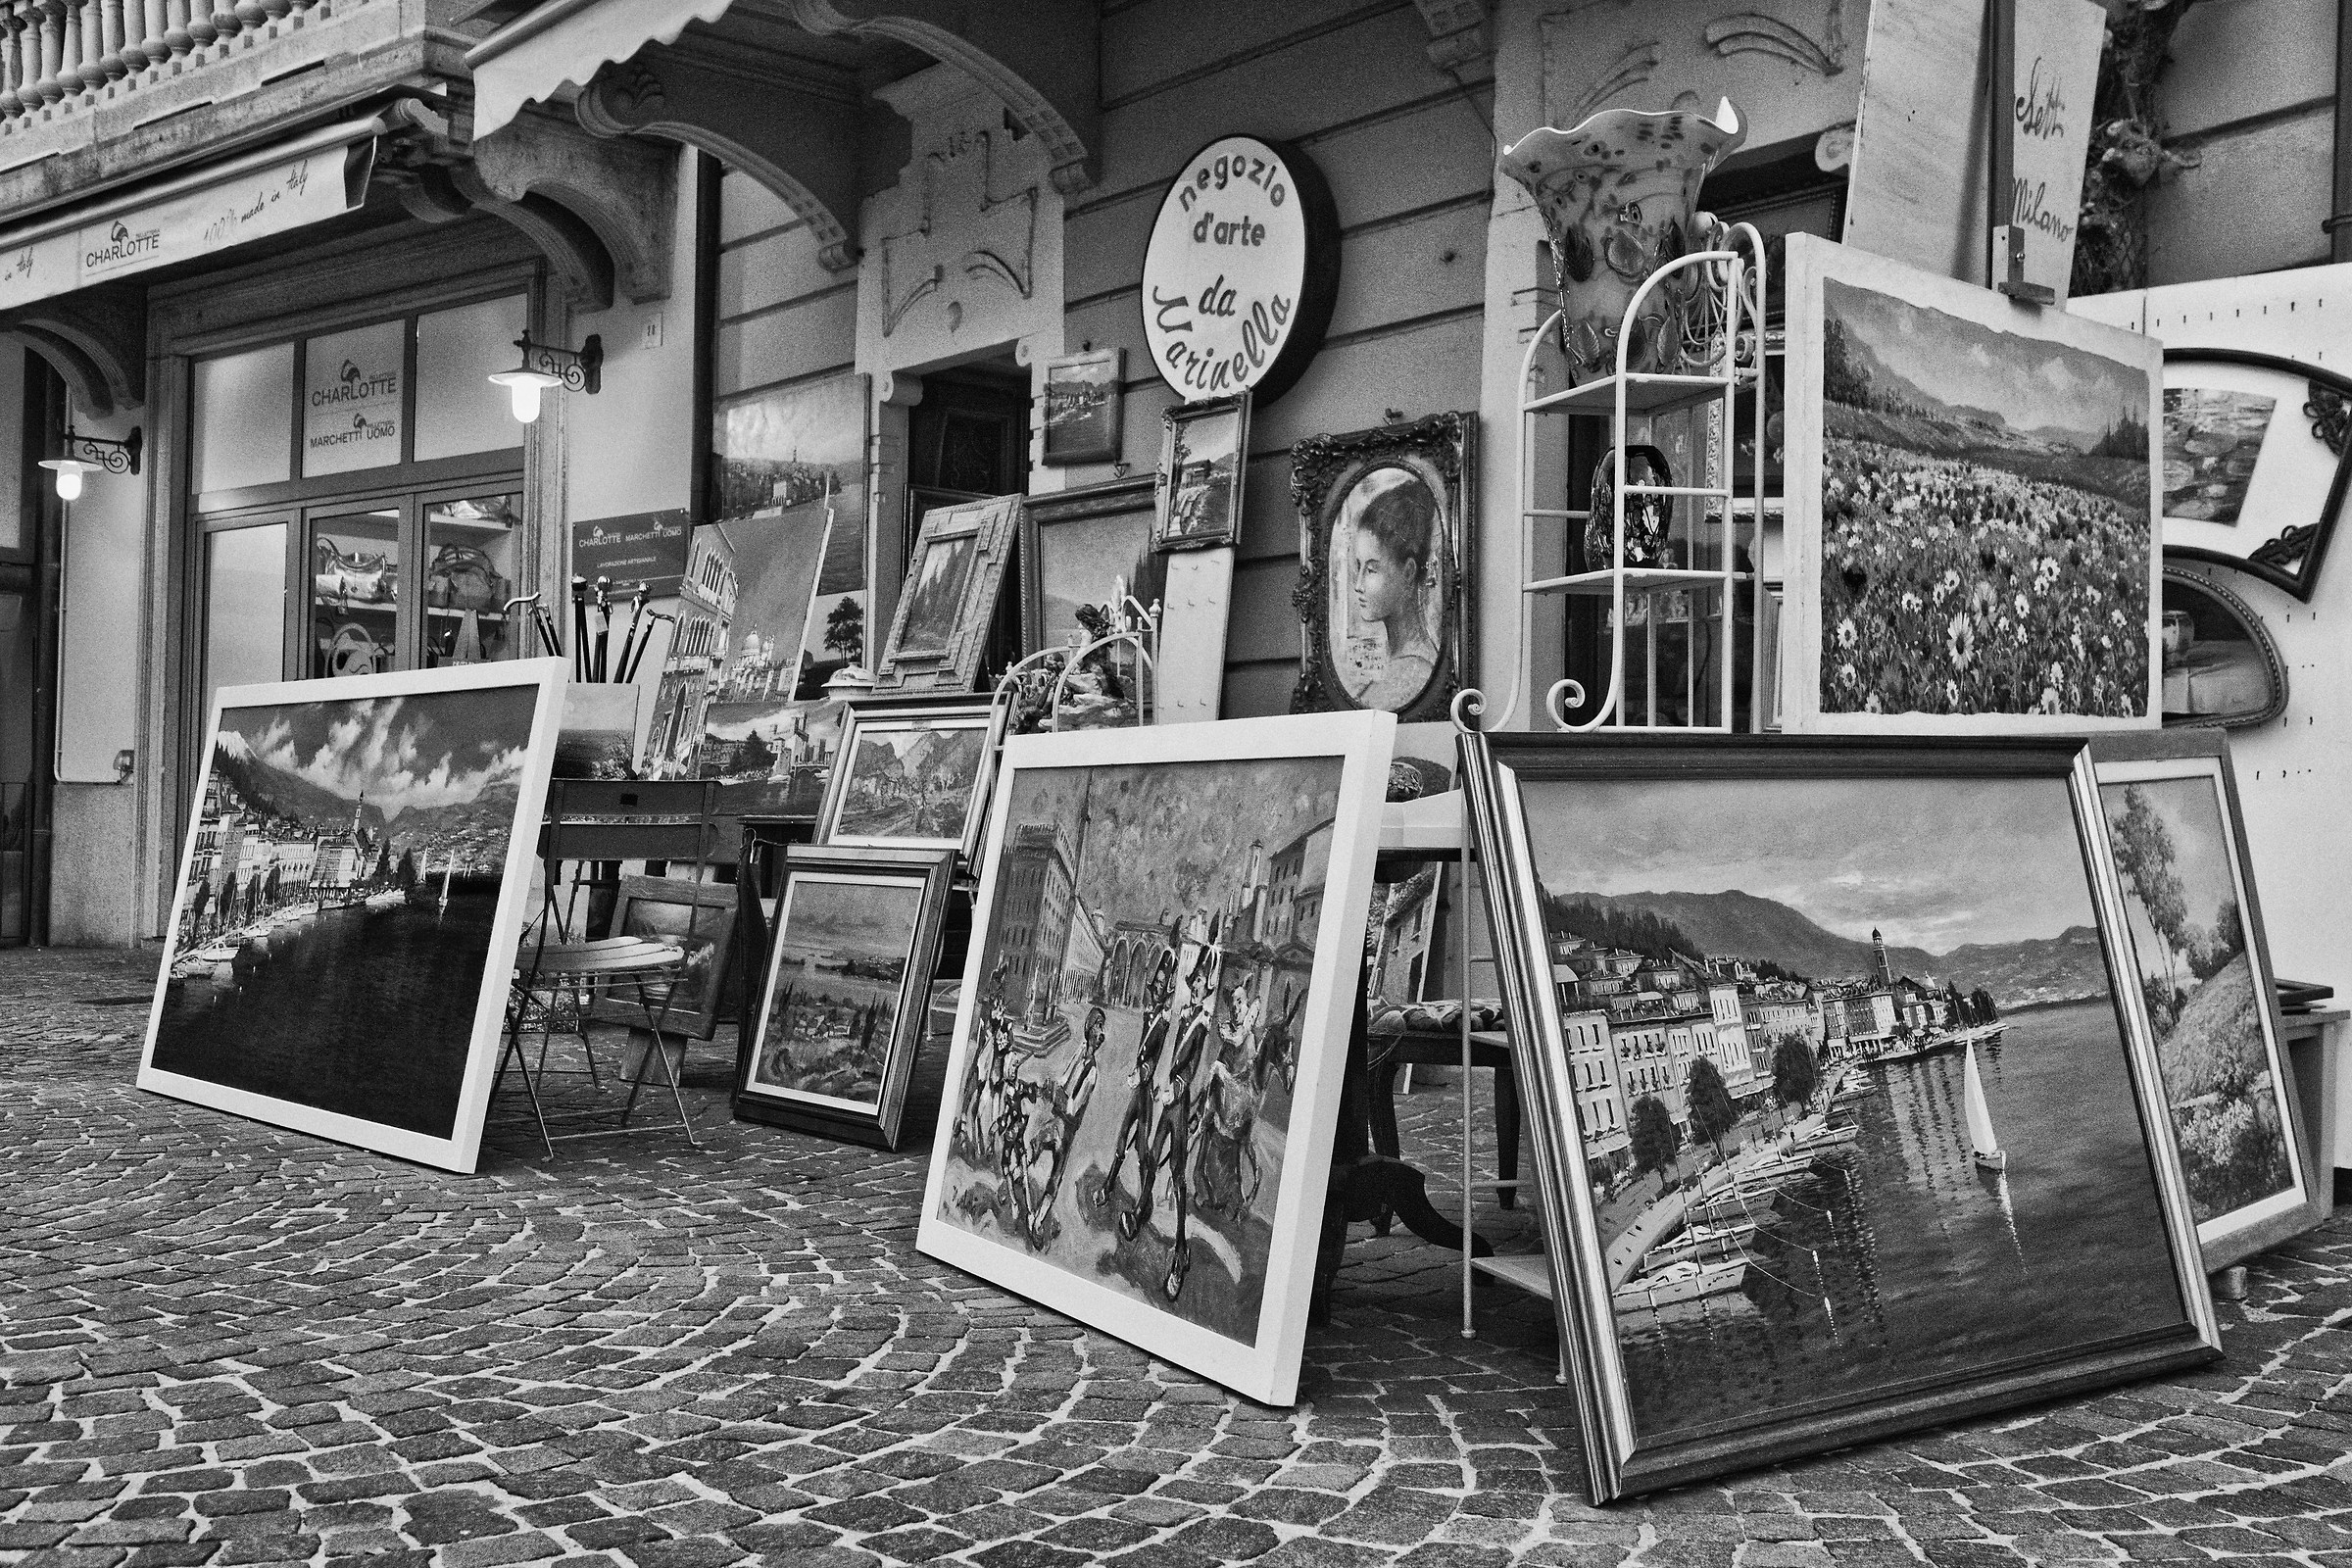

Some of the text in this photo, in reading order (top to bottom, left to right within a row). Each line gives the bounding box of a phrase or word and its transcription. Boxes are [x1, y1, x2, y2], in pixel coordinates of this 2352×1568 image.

[1178, 154, 1286, 213] negozio
[241, 191, 265, 223] made
[270, 190, 280, 203] in
[2012, 177, 2075, 243] Milano
[1193, 211, 1266, 247] d'arte
[85, 233, 160, 268] CHARLOTTE
[1198, 274, 1238, 318] da
[1152, 285, 1292, 391] Marinella
[312, 376, 397, 407] CHARLOTTE
[310, 425, 396, 449] MARCHETTI UOMO
[578, 534, 622, 548] CHARLOTTE
[625, 530, 662, 542] MARCHETTI
[662, 528, 682, 538] UOMO
